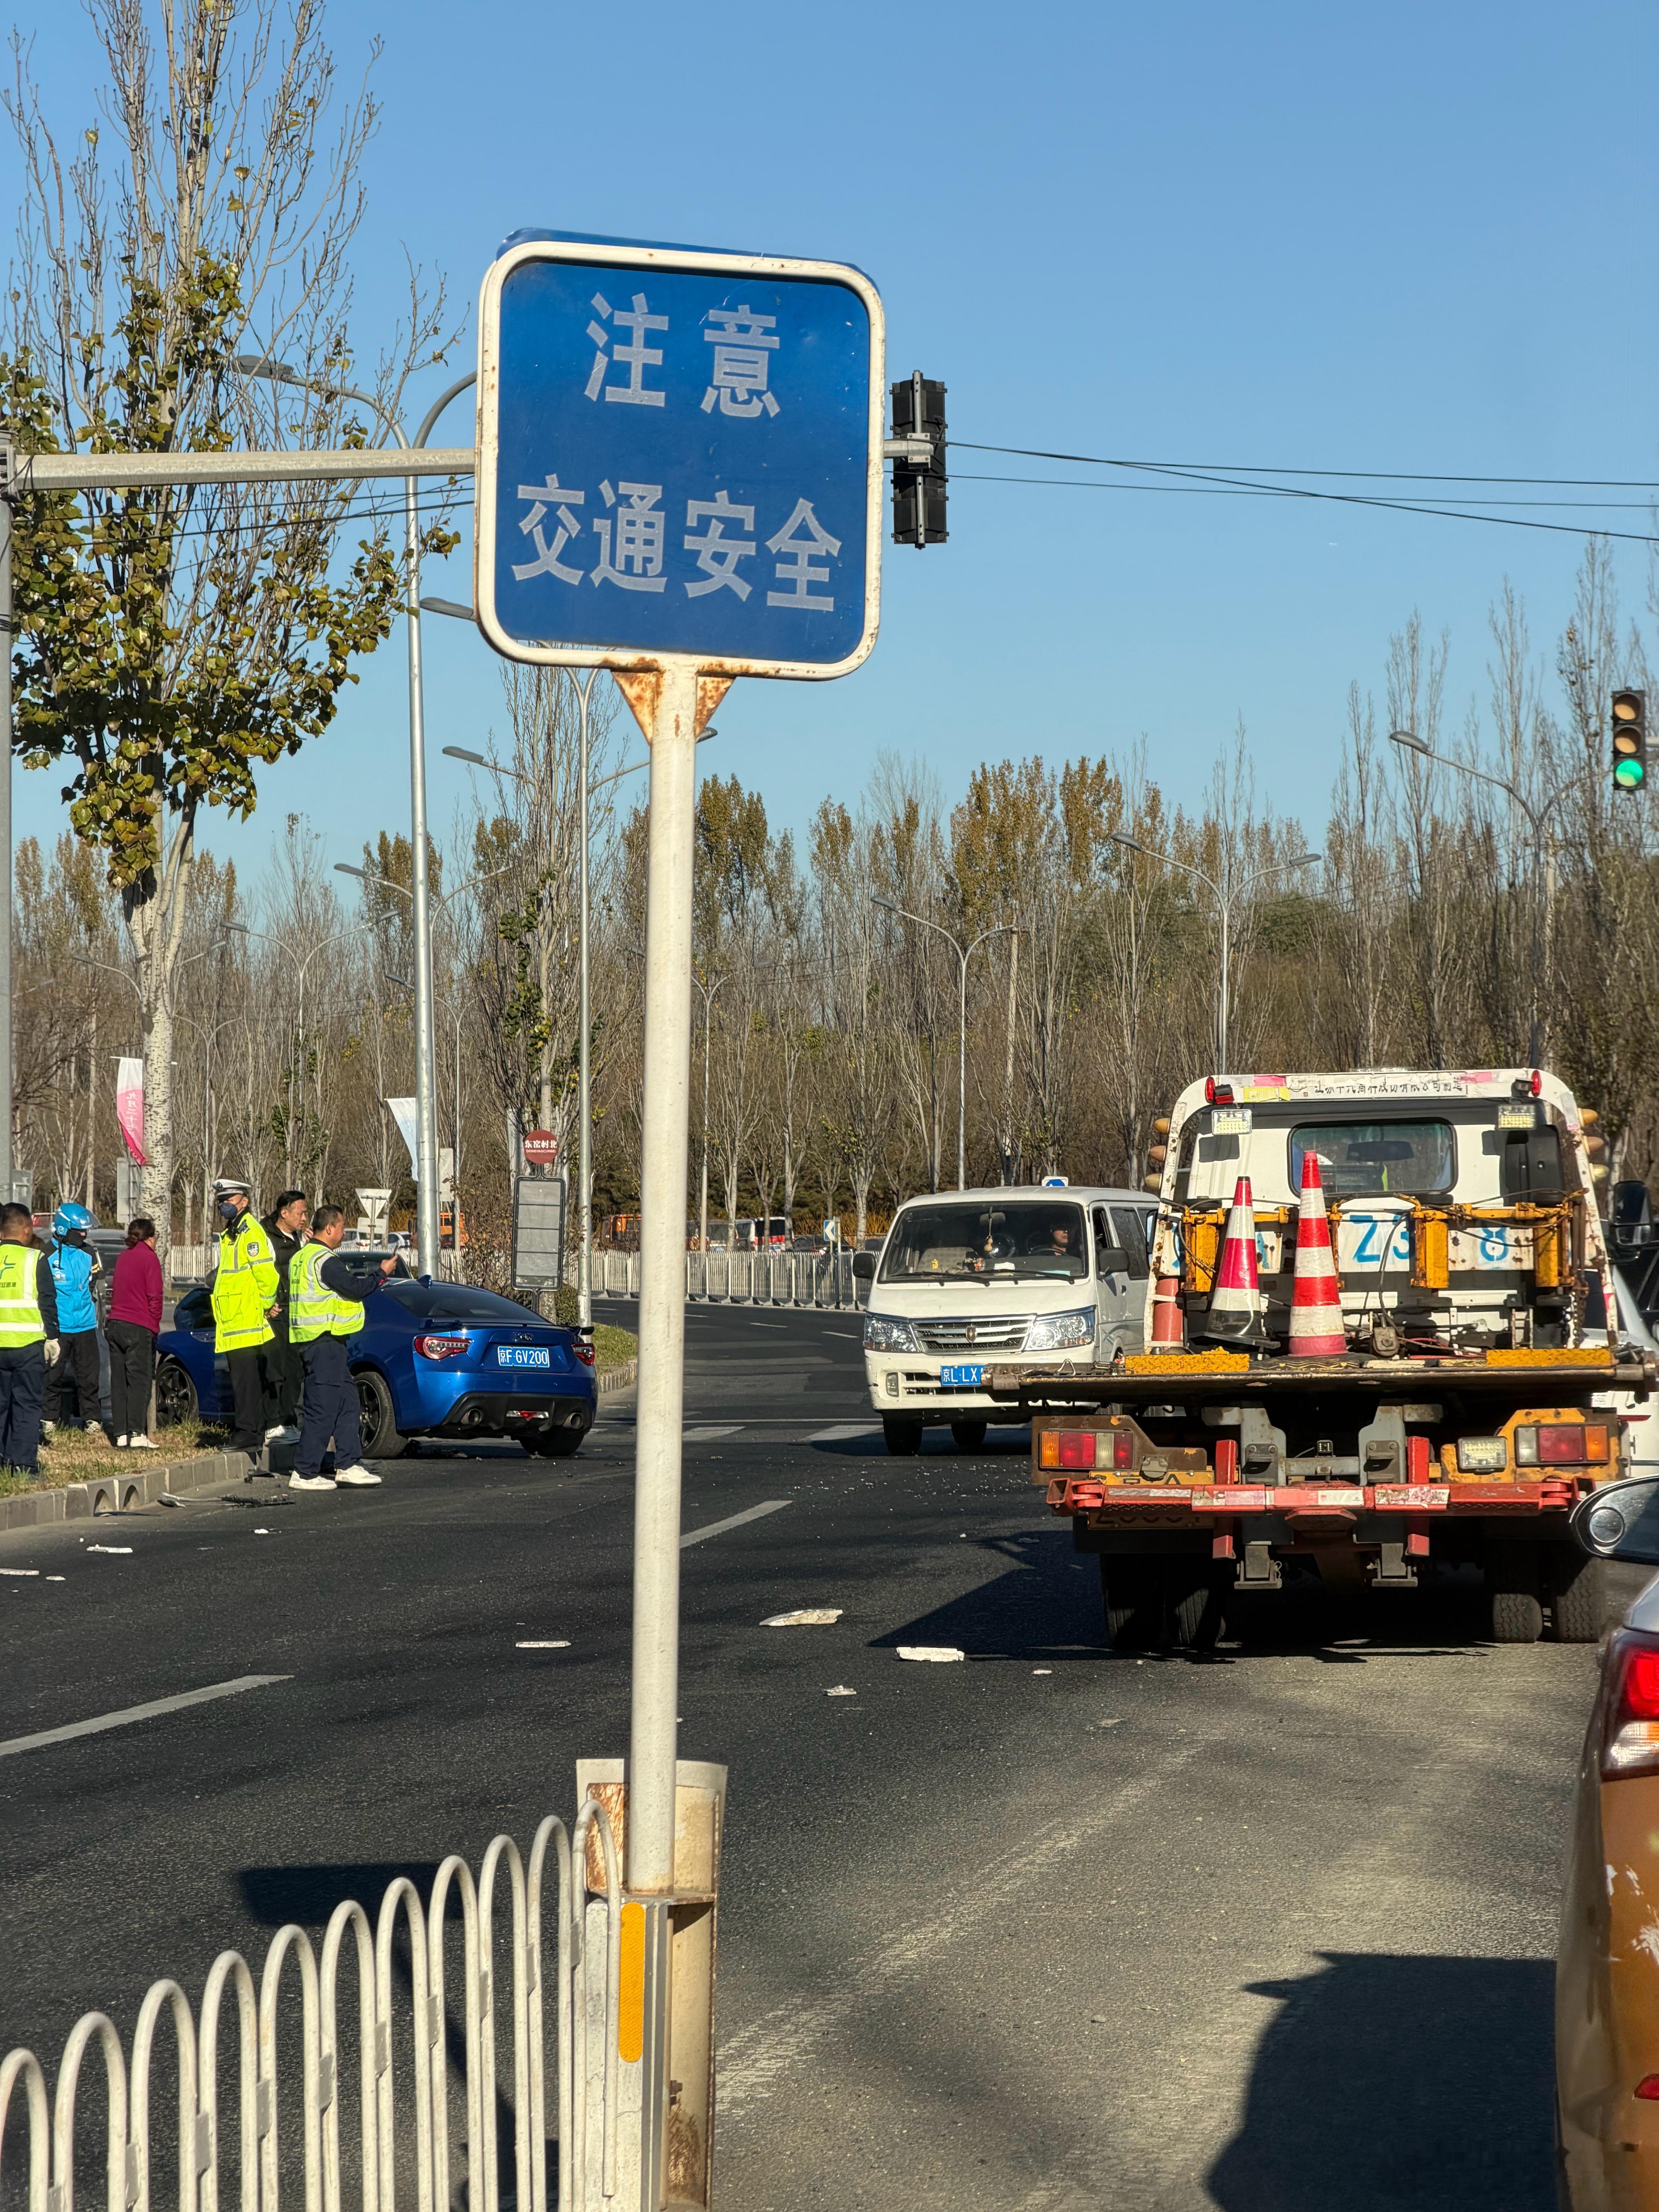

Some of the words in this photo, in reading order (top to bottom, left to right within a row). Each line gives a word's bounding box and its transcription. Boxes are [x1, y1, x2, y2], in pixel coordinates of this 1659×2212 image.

[584, 292, 781, 418] 注意
[511, 473, 842, 612] 交通安全
[943, 1367, 983, 1382] 京L·LX
